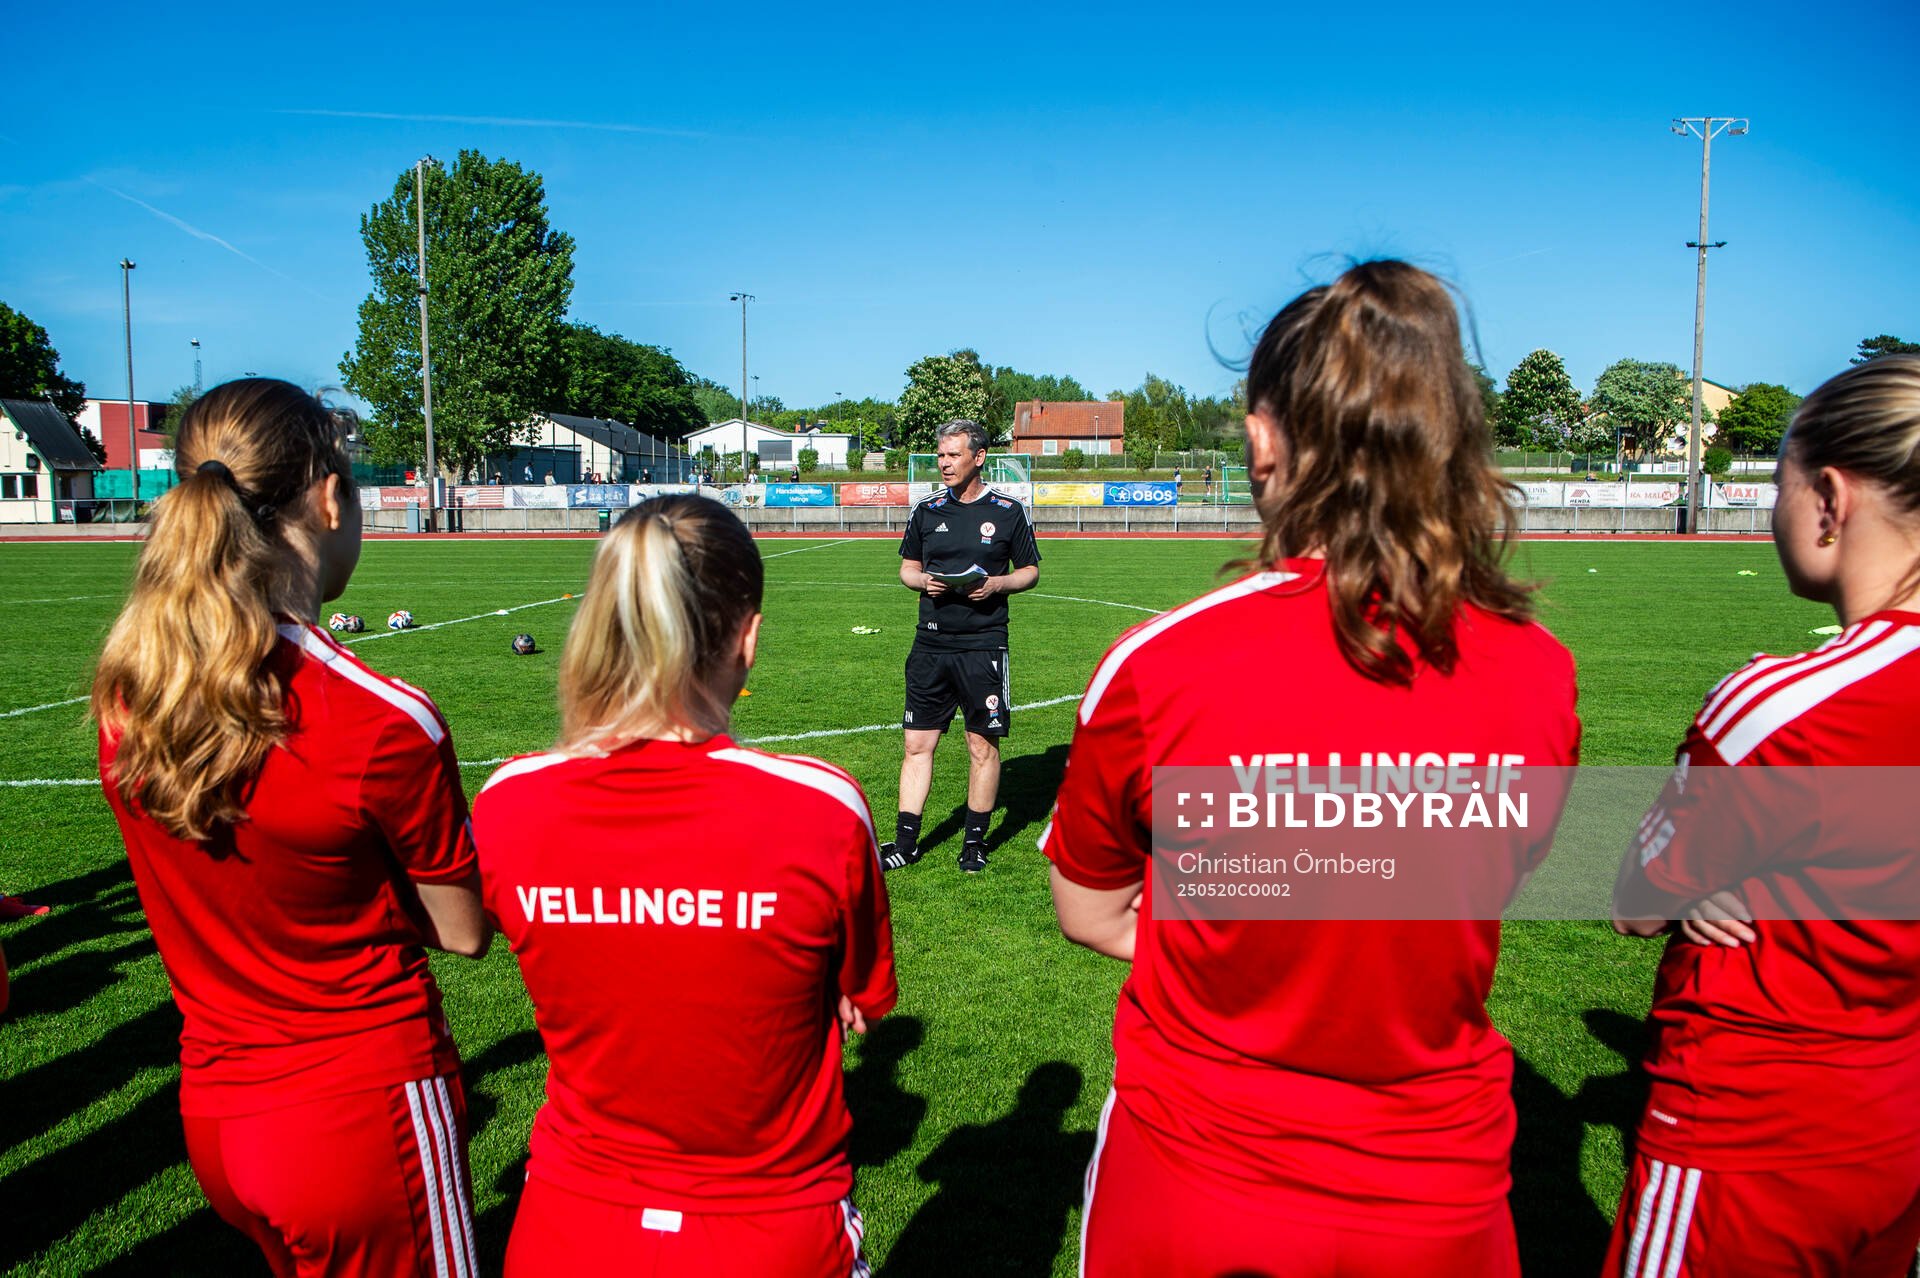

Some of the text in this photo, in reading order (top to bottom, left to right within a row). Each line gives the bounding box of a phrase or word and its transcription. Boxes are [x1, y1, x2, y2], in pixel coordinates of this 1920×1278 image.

[862, 485, 888, 495] GR8
[1132, 490, 1173, 502] OBOS
[419, 495, 428, 503] IF
[1229, 752, 1526, 795] VELLINGE IF
[516, 885, 777, 930] VELLINGE IF
